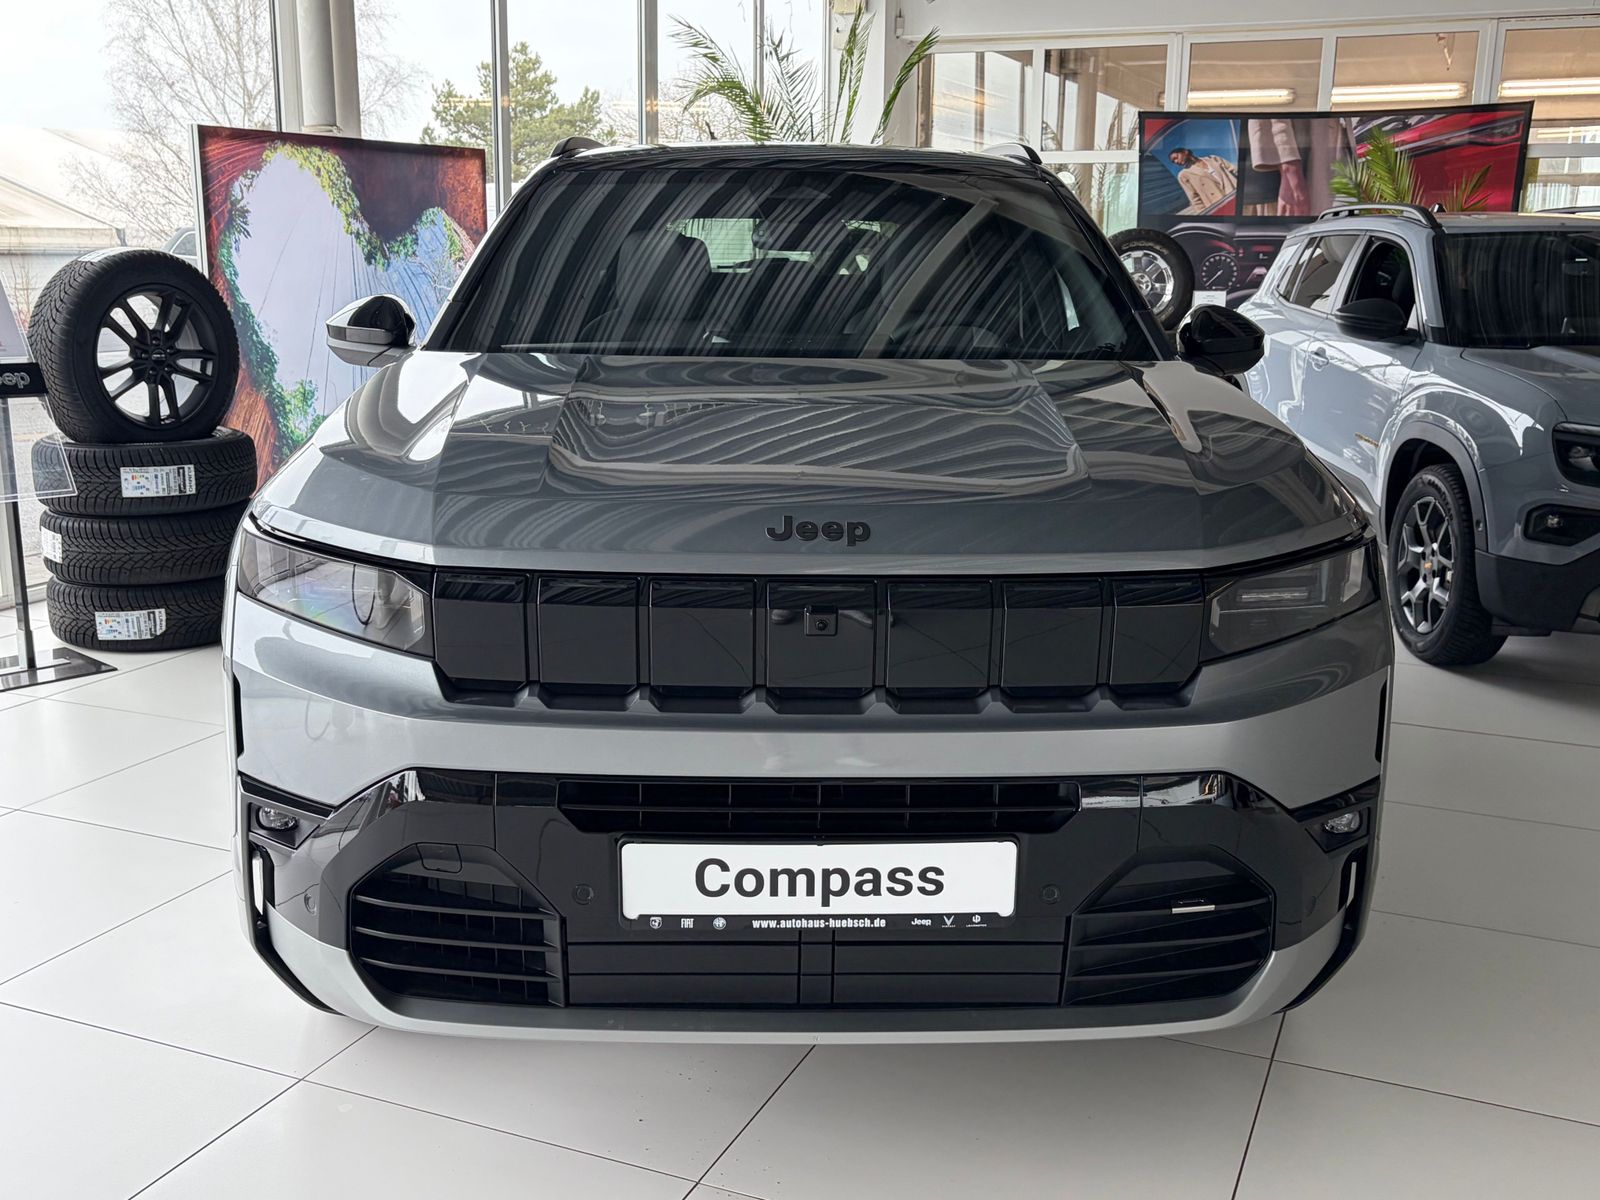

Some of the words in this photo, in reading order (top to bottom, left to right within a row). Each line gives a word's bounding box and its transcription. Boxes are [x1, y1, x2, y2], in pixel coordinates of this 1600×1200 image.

[0, 372, 30, 389] ep
[765, 515, 871, 547] Jeep
[694, 857, 945, 908] Compass
[680, 918, 695, 929] FIAT
[752, 918, 886, 929] www.autohaus-huebsch.de
[911, 918, 932, 926] Jeep
